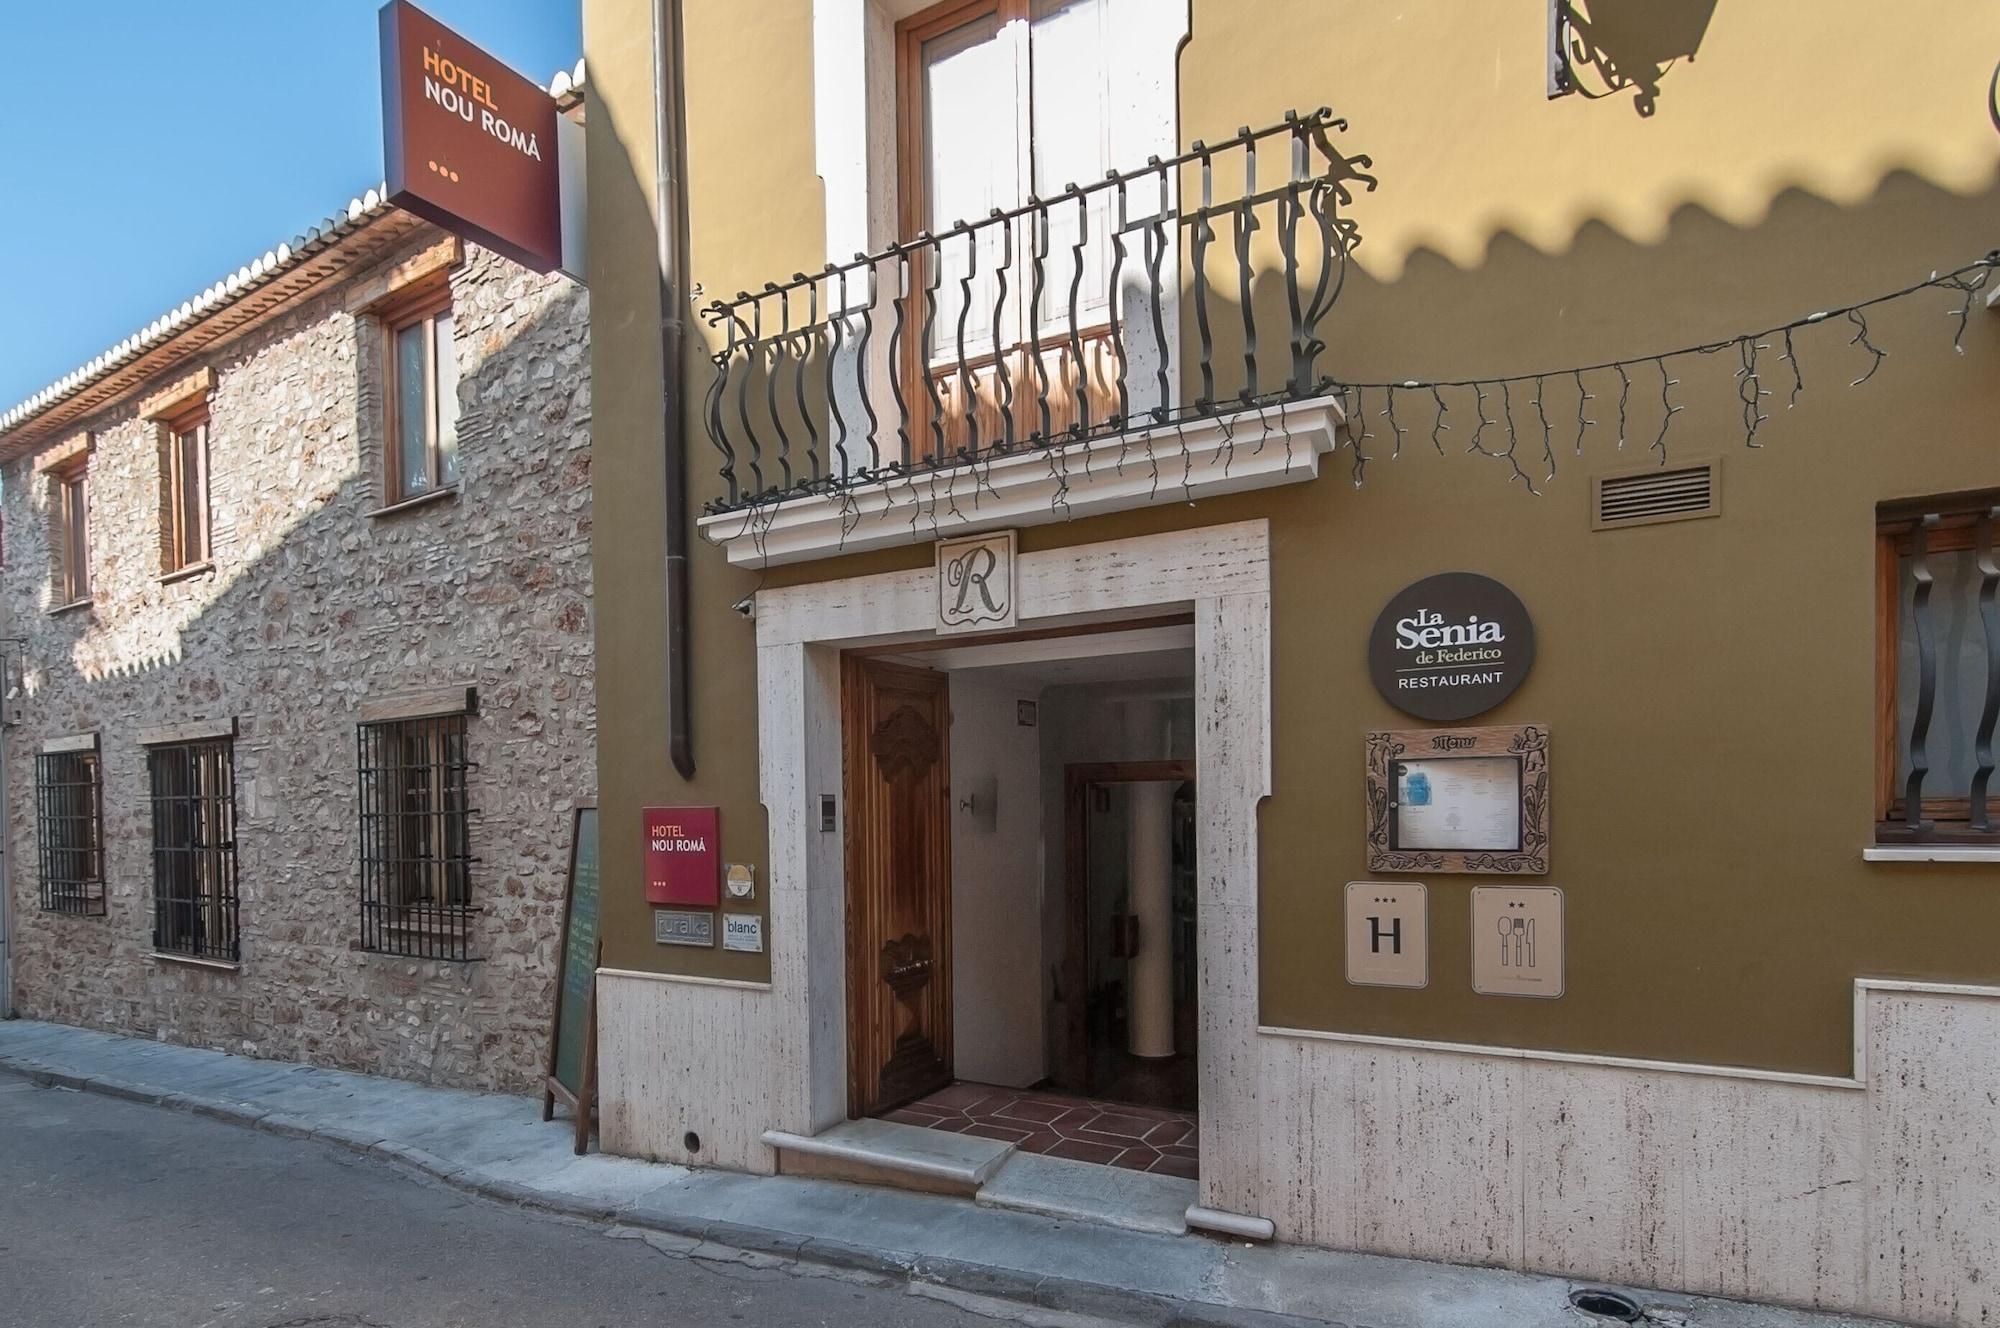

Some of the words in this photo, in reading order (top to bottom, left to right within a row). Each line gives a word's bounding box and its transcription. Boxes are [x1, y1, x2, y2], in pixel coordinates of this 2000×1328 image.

[423, 46, 498, 111] HOTEL
[425, 76, 473, 122] NOU
[948, 545, 1004, 615] R
[1417, 608, 1445, 627] La
[1416, 650, 1434, 665] de
[1438, 647, 1502, 664] Federico
[1398, 672, 1504, 689] RESTAURANT
[652, 825, 685, 838] HOTEL
[652, 839, 673, 852] NOU
[658, 914, 710, 936] ruralka
[727, 921, 758, 935] blanc
[1365, 916, 1401, 954] H
